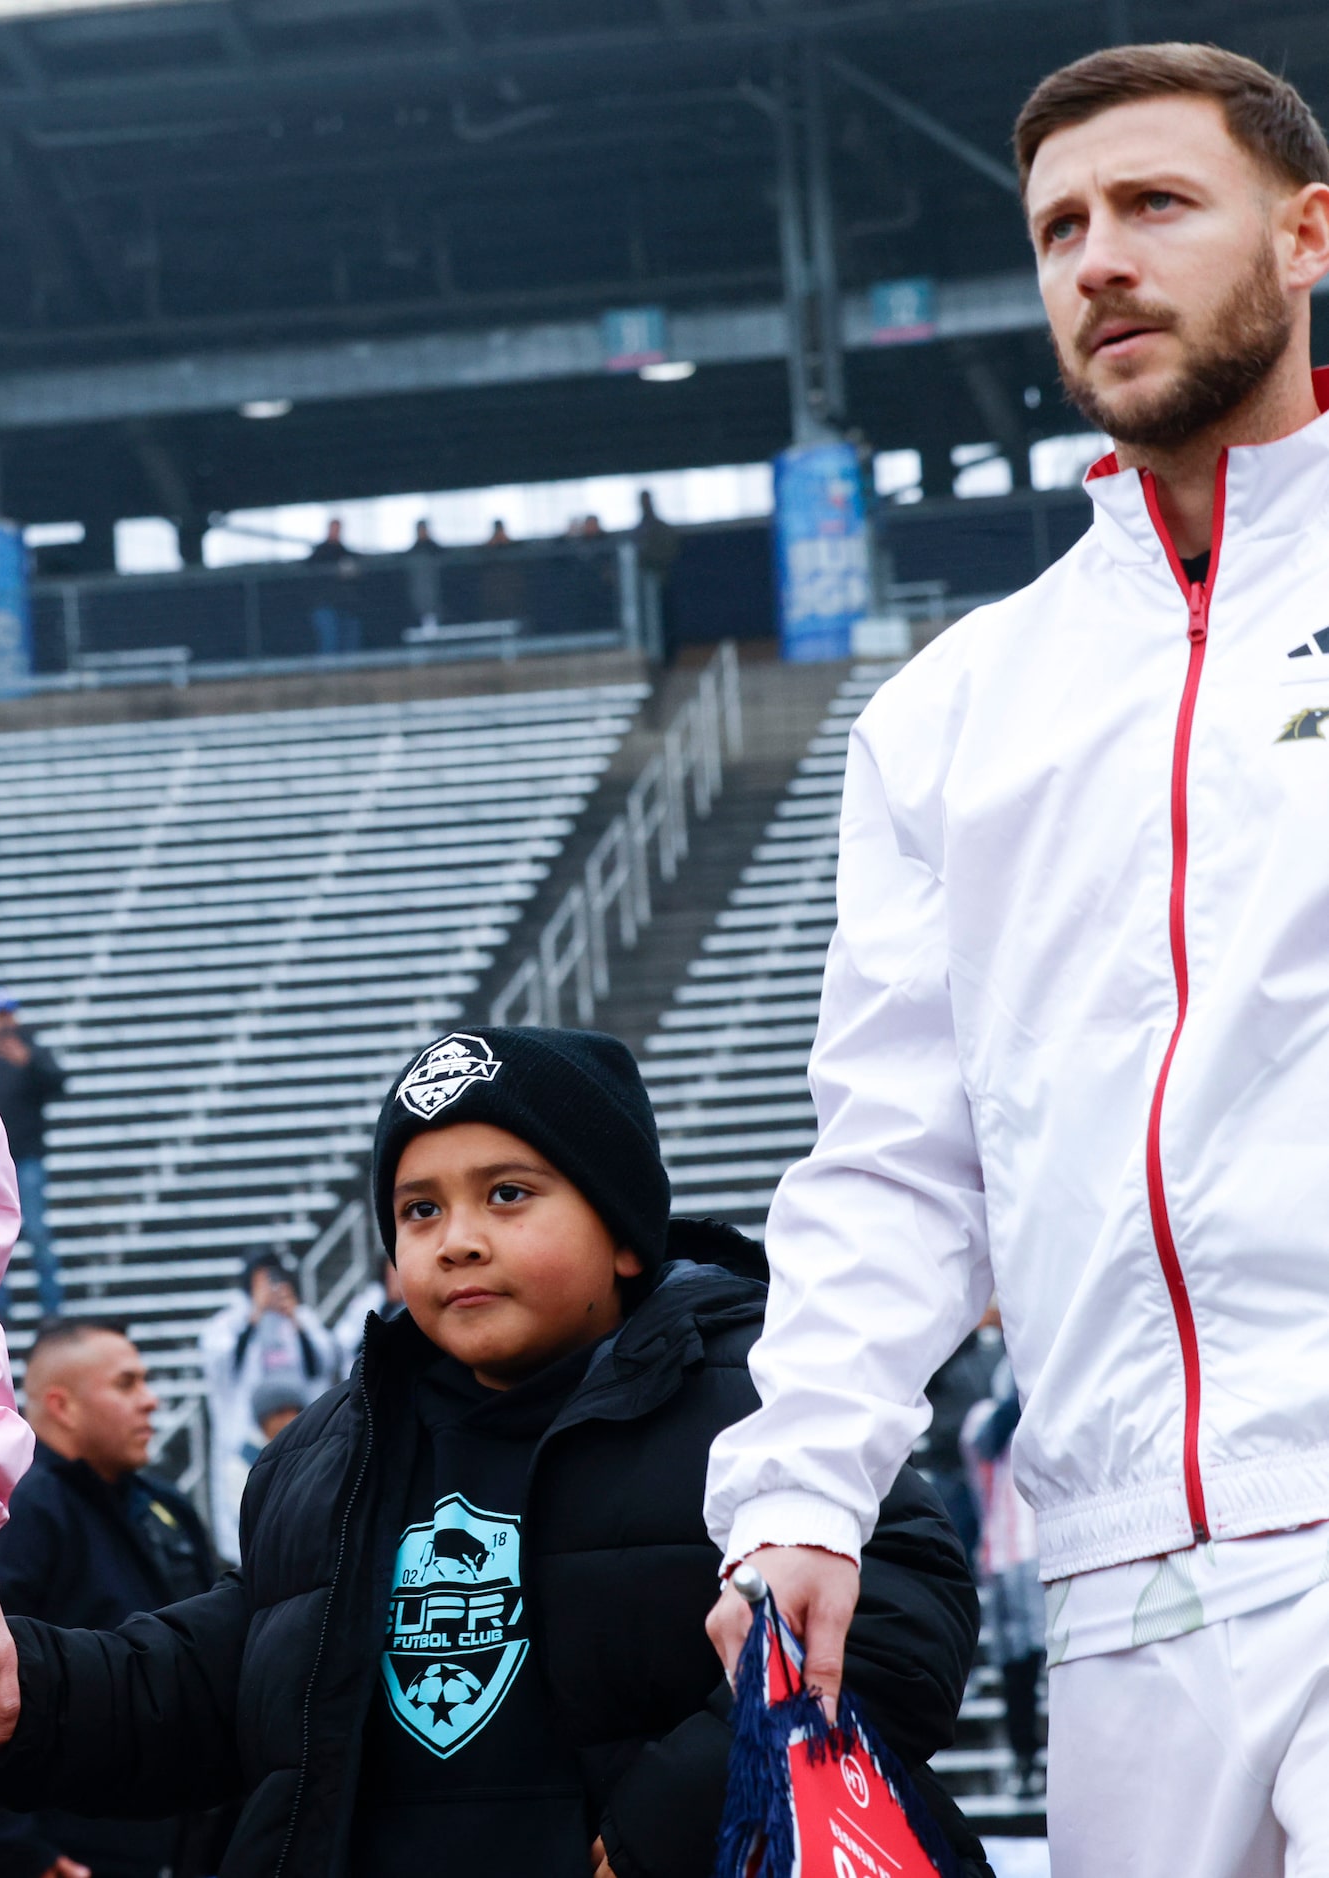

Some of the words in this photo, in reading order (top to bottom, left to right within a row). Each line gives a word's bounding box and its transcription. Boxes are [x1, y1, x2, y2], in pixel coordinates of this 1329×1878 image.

[491, 1531, 508, 1548] 18
[402, 1569, 419, 1585] 02
[392, 1632, 452, 1650] FUTBOL
[457, 1628, 504, 1647] CLUB
